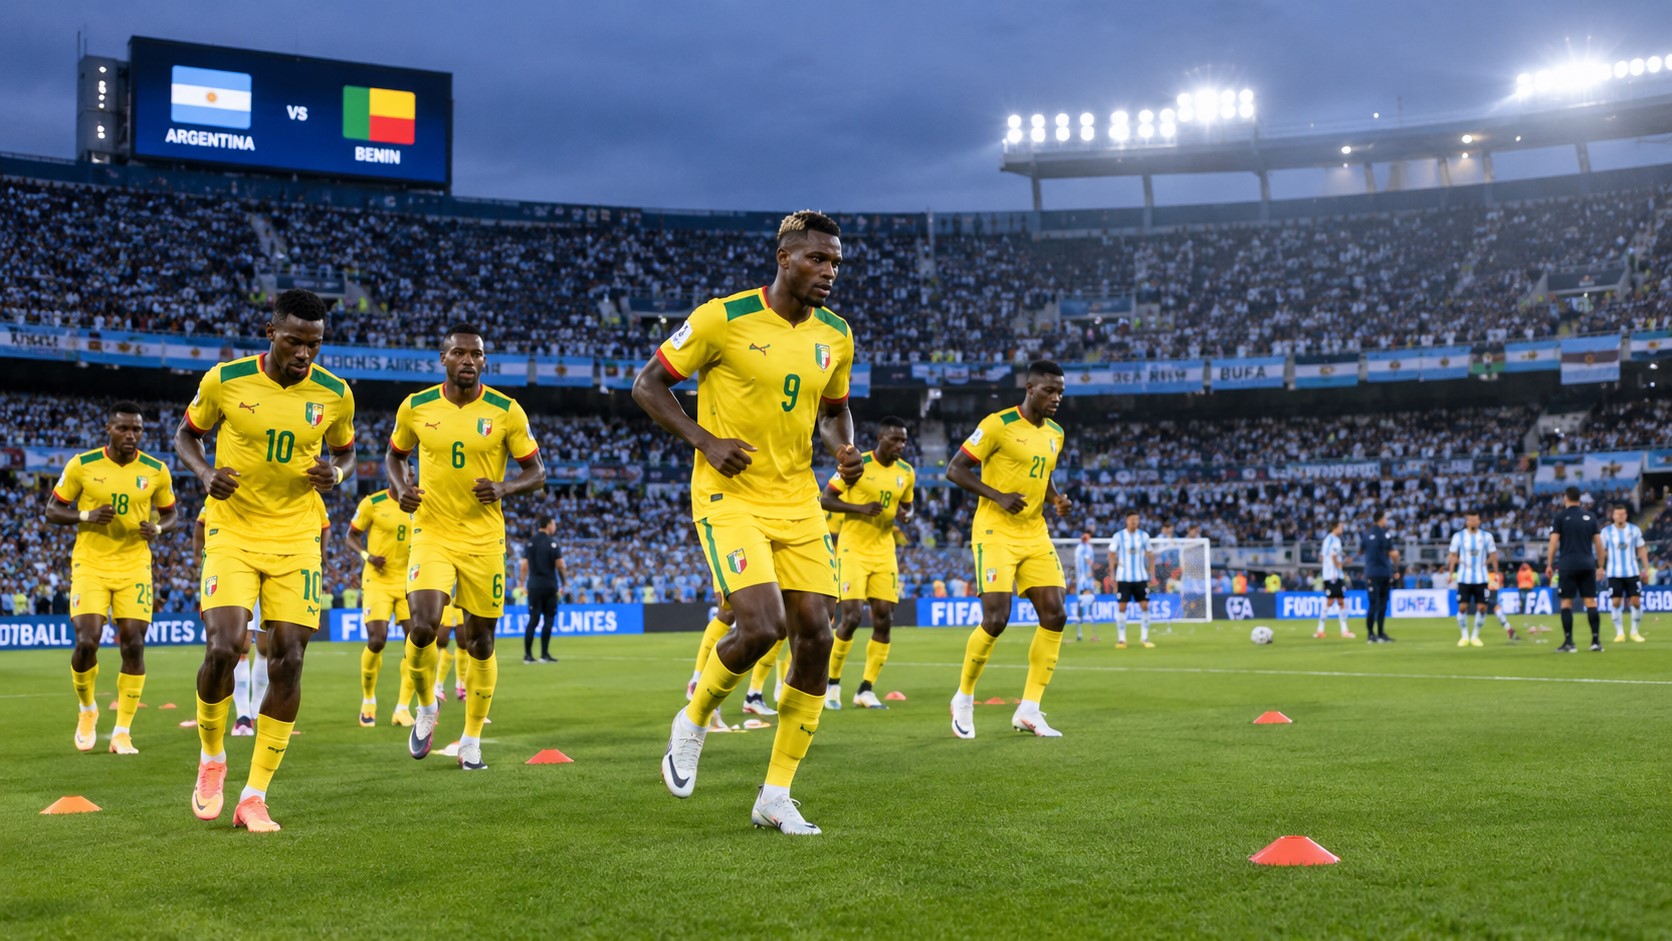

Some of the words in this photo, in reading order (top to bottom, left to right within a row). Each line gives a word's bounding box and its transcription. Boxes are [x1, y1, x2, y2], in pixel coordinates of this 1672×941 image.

[286, 105, 308, 121] VS
[165, 128, 255, 151] ARGENTINA
[355, 146, 401, 165] BENIN
[781, 373, 801, 412] 9
[266, 429, 295, 463] 10
[452, 441, 465, 469] 6
[1029, 455, 1046, 479] 21
[111, 493, 129, 515] 18
[880, 490, 892, 508] 18
[397, 524, 406, 541] 8
[301, 570, 321, 604] 10
[493, 573, 503, 599] 6
[931, 601, 984, 625] FIFA
